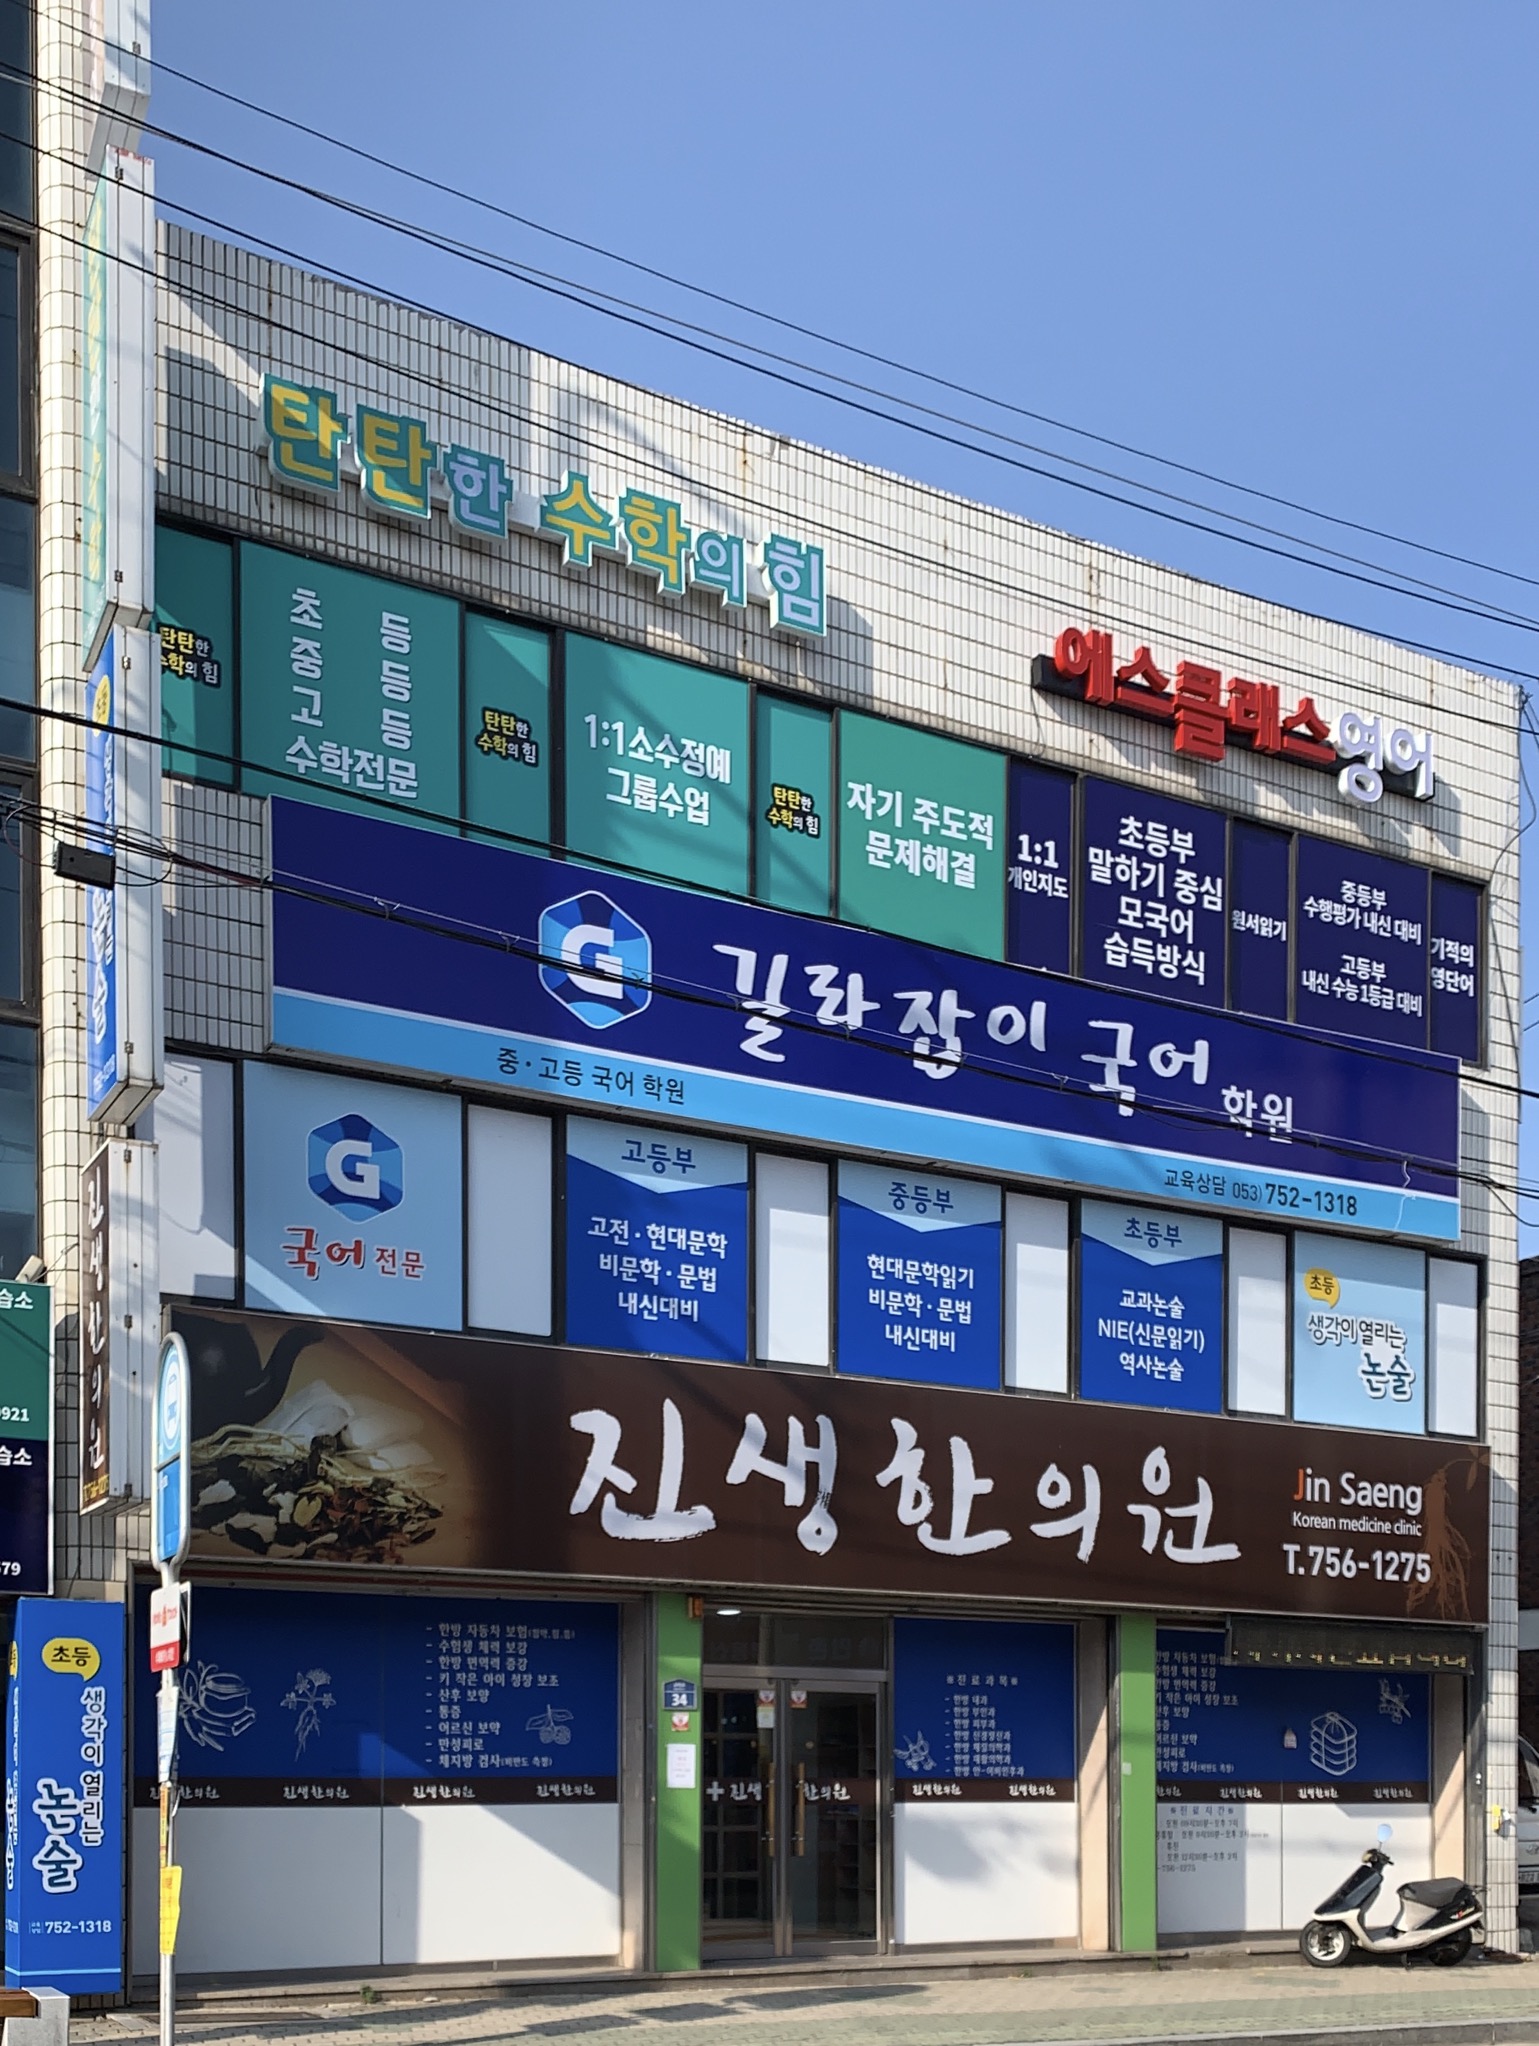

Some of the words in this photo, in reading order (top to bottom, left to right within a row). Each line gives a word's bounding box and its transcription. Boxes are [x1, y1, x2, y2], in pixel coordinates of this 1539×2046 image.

[266, 379, 511, 533] 탄탄한
[545, 478, 742, 598] 수학의
[767, 540, 822, 629] 힘
[202, 661, 218, 685] 힘
[484, 709, 530, 739] 탄탄한
[478, 734, 519, 759] 수학의
[521, 743, 538, 764] 힘
[584, 713, 731, 785] 1:1소수정예
[285, 734, 419, 800] 수학전문
[606, 766, 710, 826] 그룹수업
[773, 786, 812, 812] 탄탄한
[767, 808, 804, 831] 수학의
[806, 813, 820, 836] 힘
[847, 781, 902, 828] 자기
[913, 797, 995, 850] 주도적
[1017, 834, 1059, 869] 1:1
[1118, 816, 1196, 864] 초등부
[866, 829, 977, 890] 문제해결
[1008, 866, 1069, 898] 개인지도
[1088, 846, 1165, 898] 말하기
[1173, 868, 1224, 912] 중심
[1340, 880, 1388, 911] 중등부
[1117, 895, 1194, 944] 모국어
[1231, 909, 1288, 942] 원서읽기
[1303, 895, 1361, 931] 수행평가
[1363, 911, 1392, 938] 내신
[1393, 919, 1422, 946] 대비
[1103, 931, 1206, 987] 습득방식
[1339, 954, 1387, 984] 고등부
[1430, 937, 1475, 968] 기적의
[1302, 969, 1330, 996] 내신
[1331, 976, 1360, 1002] 수능
[1360, 984, 1395, 1010] 1등급
[1396, 992, 1423, 1017] 대비
[1430, 966, 1475, 997] 영단어
[712, 944, 1047, 1080] 길라잡이
[1080, 1020, 1210, 1117] 국어
[1221, 1085, 1293, 1144] 학원
[591, 1065, 635, 1097] 국어
[643, 1073, 685, 1106] 학원
[621, 1139, 697, 1174] 고등부
[887, 1180, 955, 1214] 중등부
[1164, 1169, 1226, 1197] 교육상담
[1265, 1182, 1358, 1217] 752-1318
[1123, 1217, 1183, 1249] 초등부
[282, 1226, 367, 1281] 국어
[375, 1246, 426, 1280] 전문
[866, 1253, 976, 1291] 현대문학읽기
[1309, 1273, 1335, 1296] 초등
[88, 1166, 106, 1470] 진생한의원
[617, 1290, 700, 1323] 내신대비
[1118, 1289, 1186, 1320] 교과논술
[884, 1324, 957, 1353] 내신대비
[1098, 1317, 1206, 1355] NIE(신문읽기)
[1307, 1313, 1356, 1343] 생각이
[1358, 1318, 1405, 1350] 열리는
[1119, 1353, 1185, 1383] 역사논술
[1360, 1351, 1413, 1396] 논술
[569, 1397, 1242, 1566] 진생한의원
[1293, 1467, 1331, 1503] Jin
[1340, 1472, 1423, 1517] Saeng
[1292, 1510, 1337, 1530] Korean
[1338, 1515, 1392, 1534] medicine
[1393, 1519, 1423, 1537] clinic
[439, 1623, 461, 1637] 한방
[467, 1623, 500, 1638] 자동차
[439, 1639, 473, 1654] 수험생
[505, 1641, 527, 1655] 보강
[50, 1644, 92, 1668] 초등
[439, 1655, 461, 1670] 한방
[467, 1656, 500, 1671] 면역력
[506, 1657, 528, 1671] 증강
[438, 1688, 461, 1703] 산후
[440, 1672, 450, 1686] 키
[455, 1672, 478, 1687] 작은
[483, 1673, 505, 1687] 아이
[511, 1674, 533, 1688] 성장
[537, 1674, 559, 1687] 보조
[438, 1705, 461, 1719] 통증
[671, 1693, 688, 1706] 34
[81, 1688, 106, 1766] 생각이
[438, 1721, 473, 1736] 어르신
[477, 1721, 501, 1736] 보약
[438, 1738, 484, 1752] 만성피로
[438, 1754, 473, 1768] 체지방
[283, 1785, 350, 1799] 진생한의원
[413, 1785, 475, 1799] 진생한의원
[536, 1783, 596, 1798] 진생한의원
[912, 1783, 962, 1797] 진생한의원
[1009, 1783, 1056, 1797] 진생한의원
[81, 1772, 105, 1846] 열리는
[35, 1781, 80, 1889] 논술
[44, 1919, 112, 1935] 752-1318
